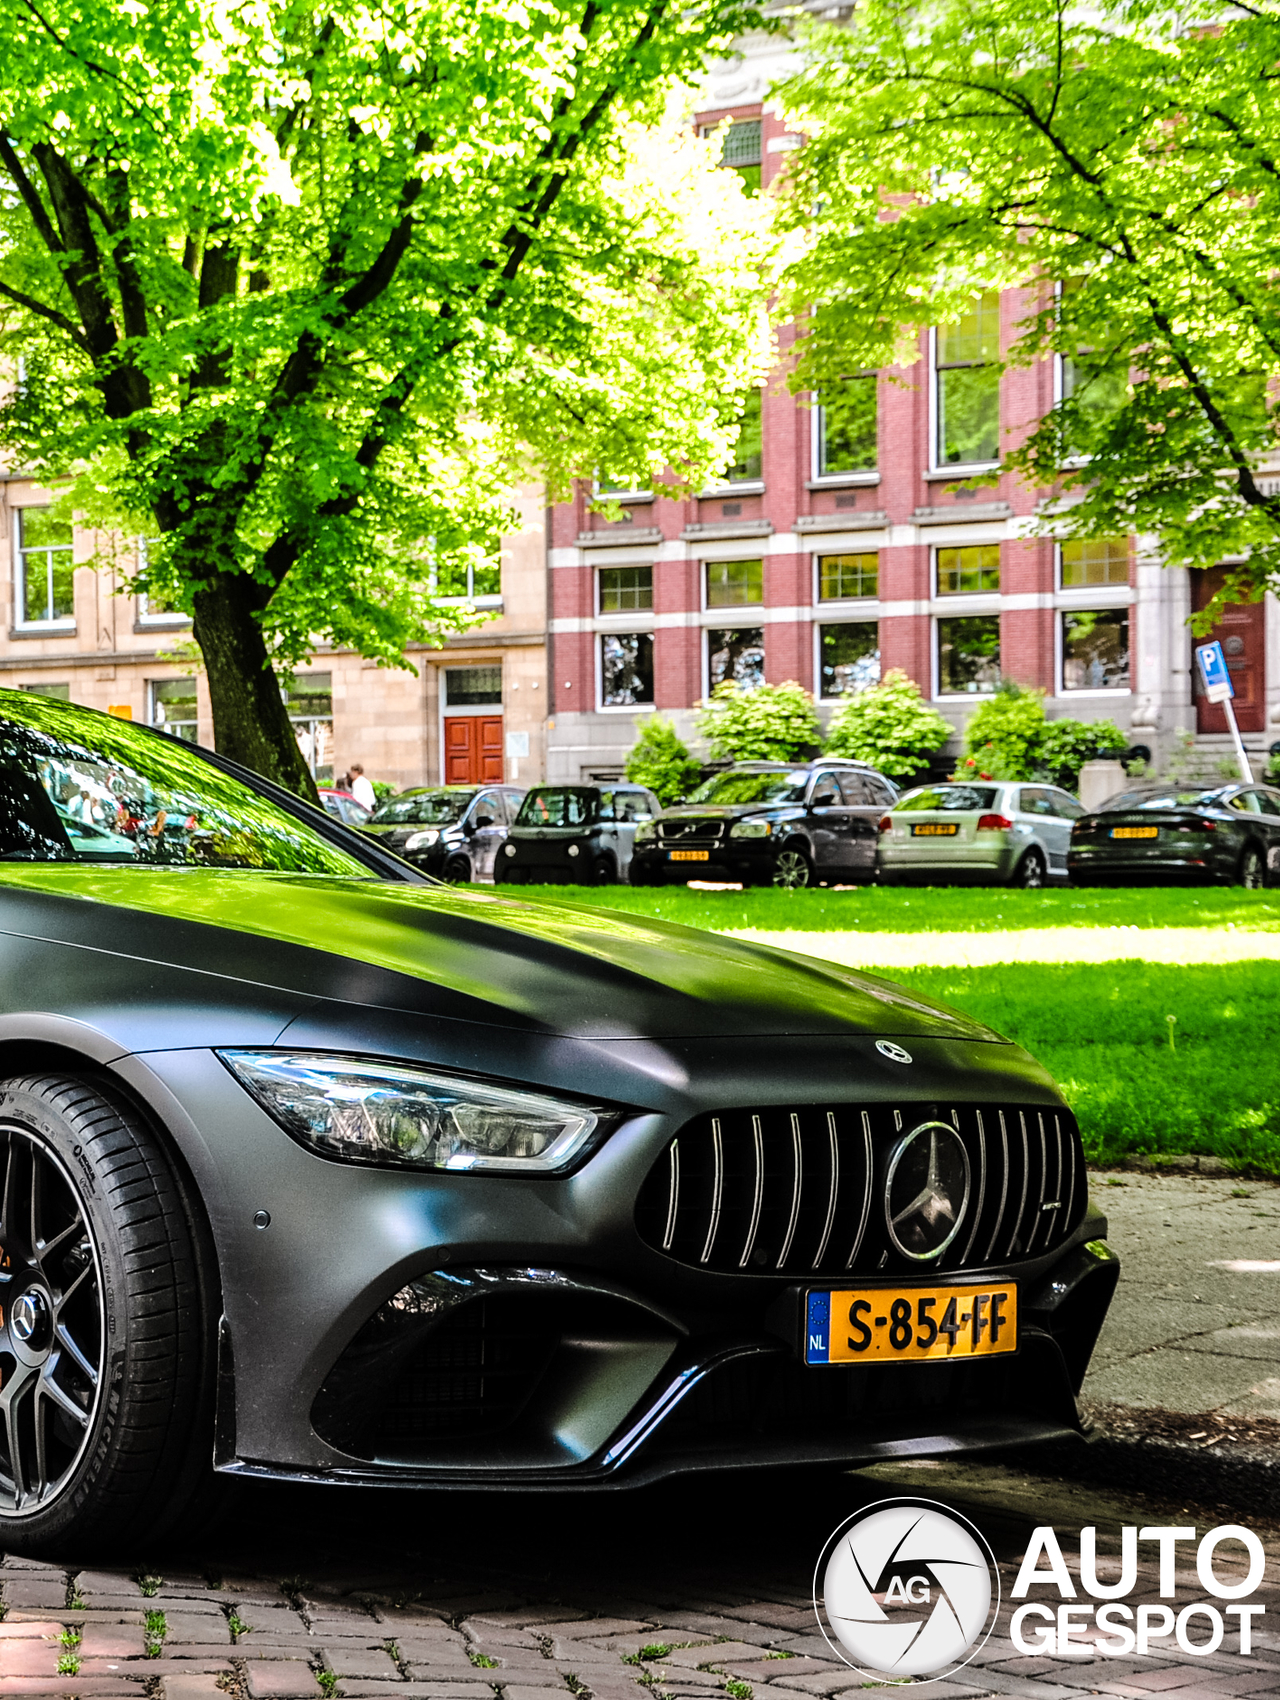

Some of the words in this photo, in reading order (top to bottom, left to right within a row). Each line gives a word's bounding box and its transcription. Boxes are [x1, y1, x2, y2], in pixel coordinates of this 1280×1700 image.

[1202, 649, 1216, 671] P
[847, 1292, 1008, 1351] S-854-FF
[809, 1335, 826, 1351] NL
